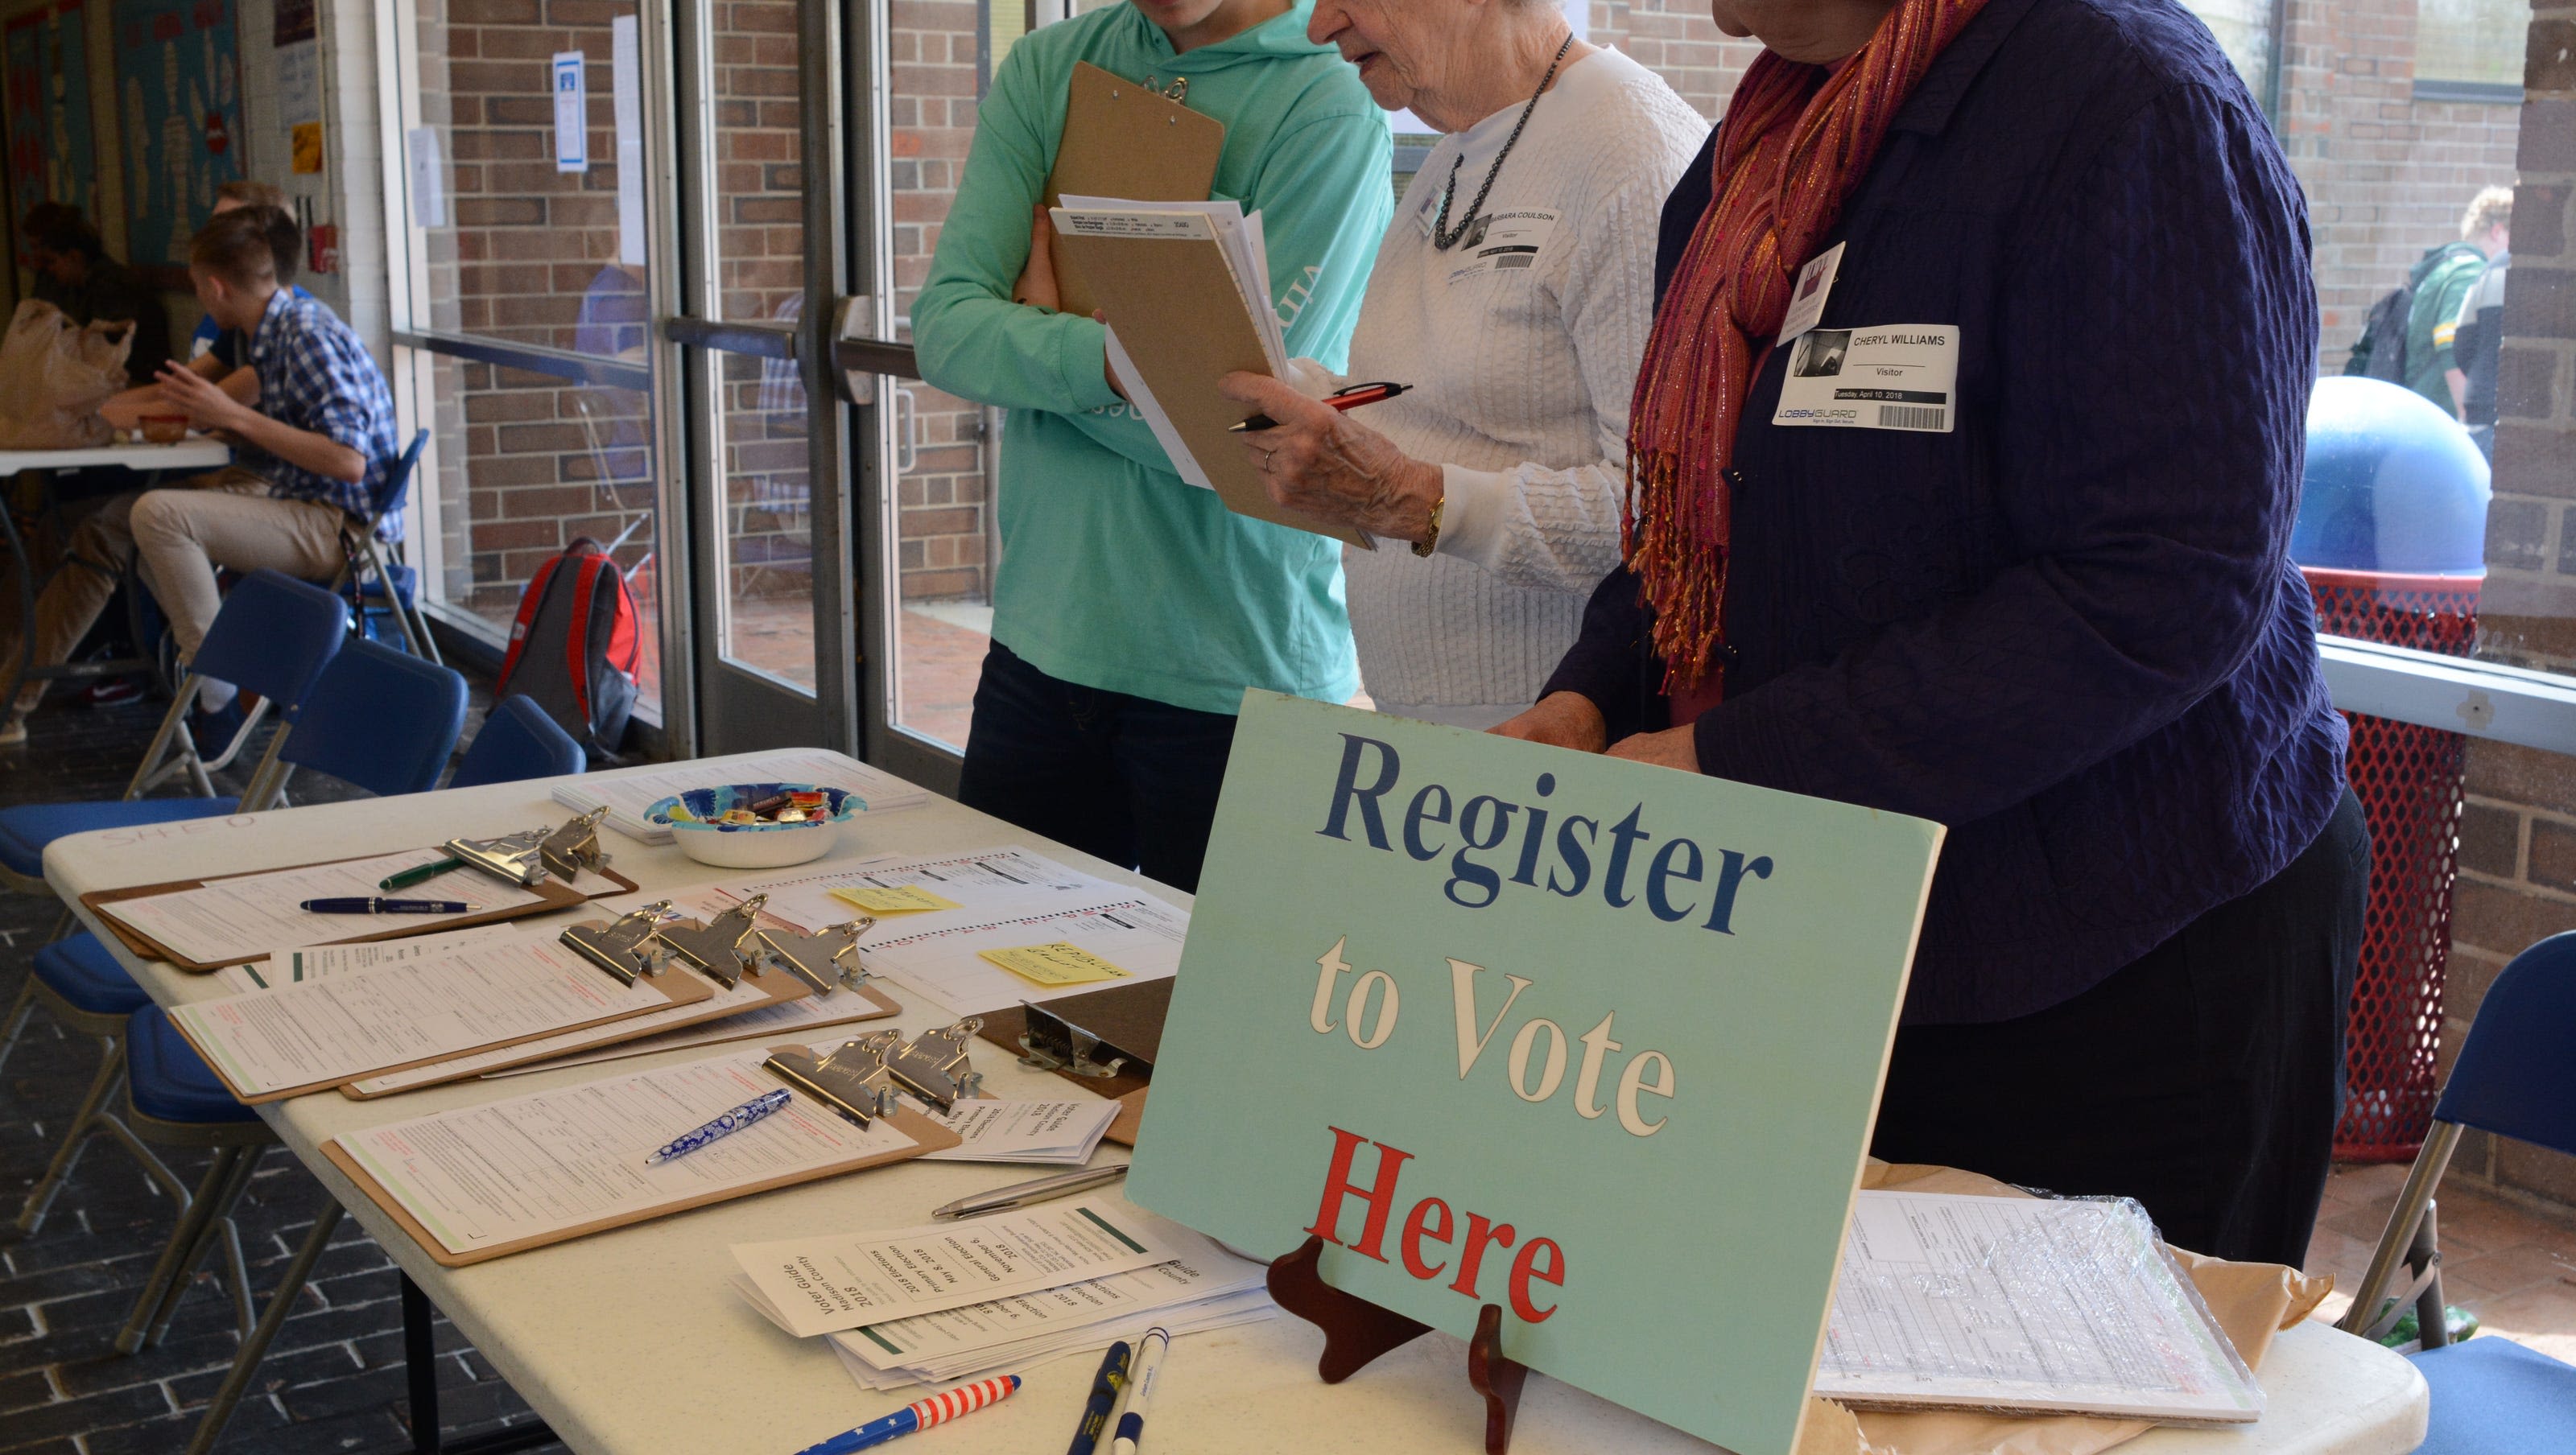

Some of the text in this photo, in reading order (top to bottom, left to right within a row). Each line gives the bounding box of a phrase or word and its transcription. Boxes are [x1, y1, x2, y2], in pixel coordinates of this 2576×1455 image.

[1517, 212, 1554, 221] COULSON
[1854, 334, 1945, 346] CHERYL WILLIAMS
[1876, 367, 1903, 377] Visitor
[1859, 390, 1872, 399] April
[1885, 391, 1903, 400] 2018
[1778, 409, 1856, 418] LOBBYGUARD
[1315, 732, 1773, 936] Register
[1309, 934, 1677, 1137] to Vote
[1302, 1125, 1567, 1325] Here
[912, 1247, 935, 1263] 2018
[942, 1236, 1001, 1282] General Election
[975, 1243, 1017, 1273] November
[994, 1243, 1019, 1259] 2018
[868, 1250, 920, 1293] 2018 Elections
[886, 1244, 944, 1292] Primary Election
[937, 1270, 958, 1284] May
[1155, 1267, 1192, 1285] County
[1164, 1259, 1202, 1277] Guide
[779, 1263, 836, 1314] Voter Guide
[793, 1255, 855, 1311] Madison County
[844, 1285, 873, 1307] 2018
[1053, 1293, 1078, 1305] 2018
[1070, 1286, 1105, 1305] Election
[972, 1304, 994, 1313] 018
[1013, 1300, 1051, 1318] Election
